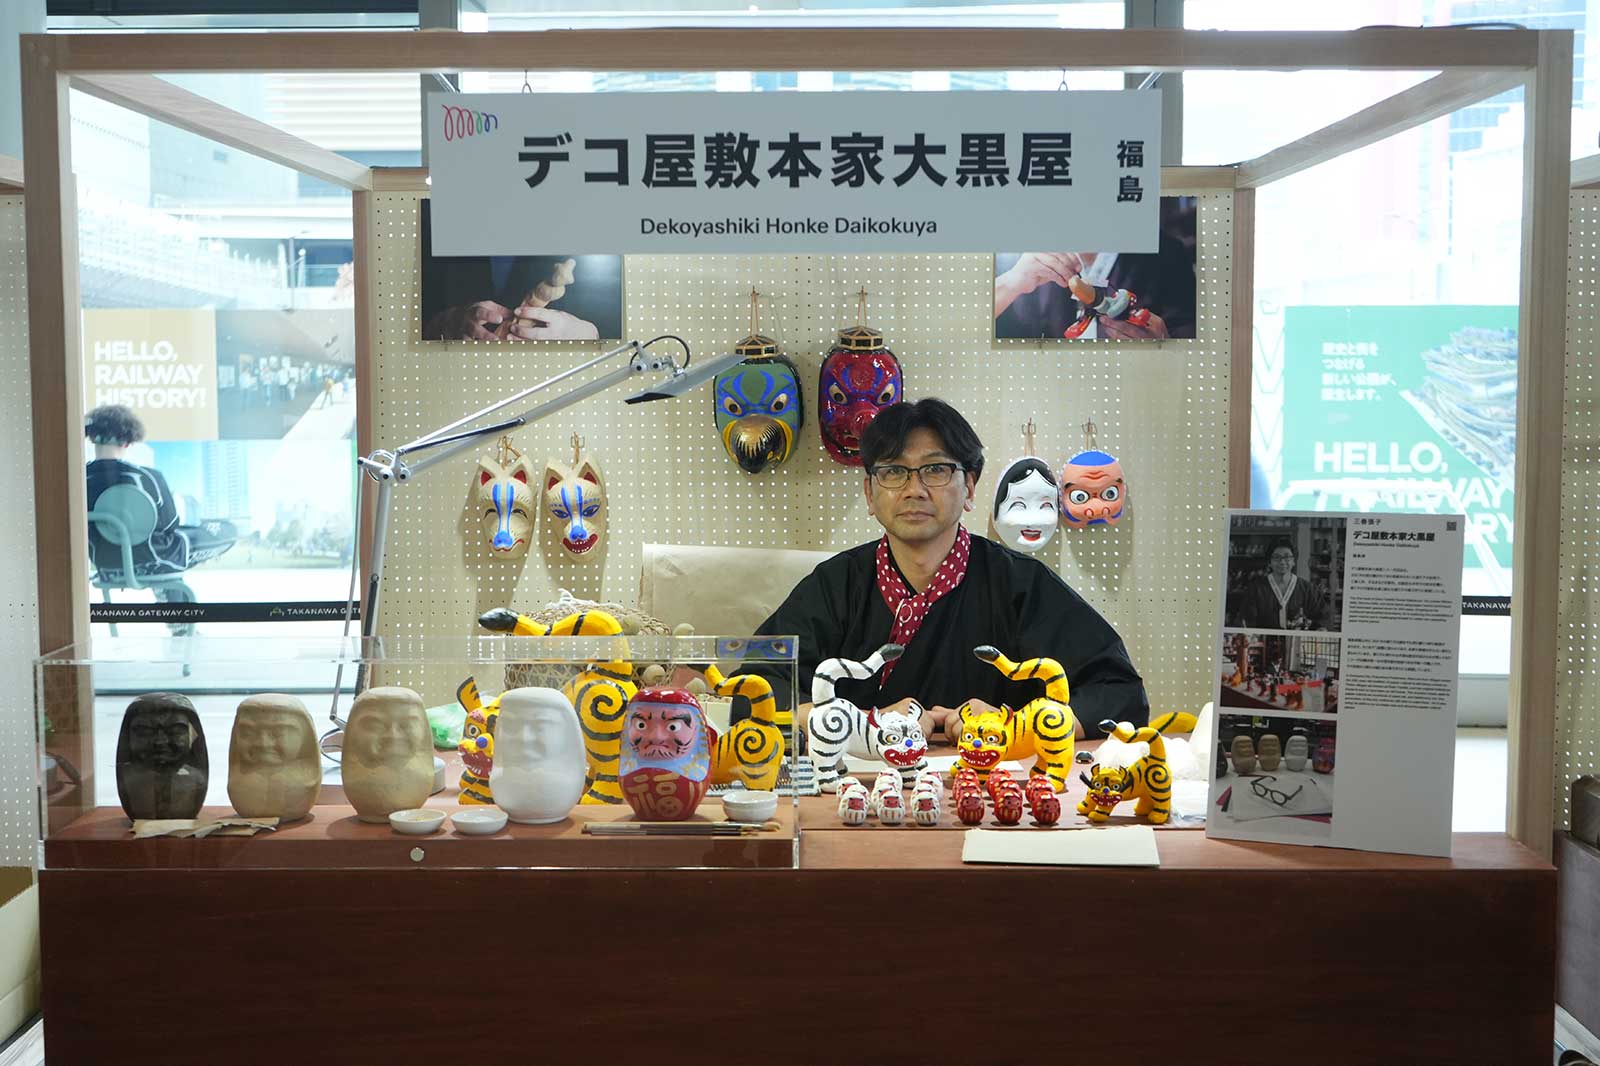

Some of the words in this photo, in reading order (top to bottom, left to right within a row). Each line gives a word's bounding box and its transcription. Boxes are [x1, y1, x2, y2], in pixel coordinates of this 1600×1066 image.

[518, 131, 1073, 189] デコ屋敷本家大黒屋
[1116, 140, 1145, 203] 福島
[641, 217, 760, 238] Dekoyashiki
[766, 217, 829, 234] Honke
[835, 217, 937, 237] Daikokuya
[94, 340, 178, 361] HELLO,
[95, 363, 204, 385] RAILWAY
[95, 387, 207, 409] HISTORY!
[1314, 441, 1448, 474] HELLO,
[90, 609, 136, 617] AKANAWA
[138, 609, 182, 617] GATEWAY
[184, 608, 205, 616] CITY
[286, 607, 338, 615] TAKANAWA
[625, 773, 684, 818] 福
